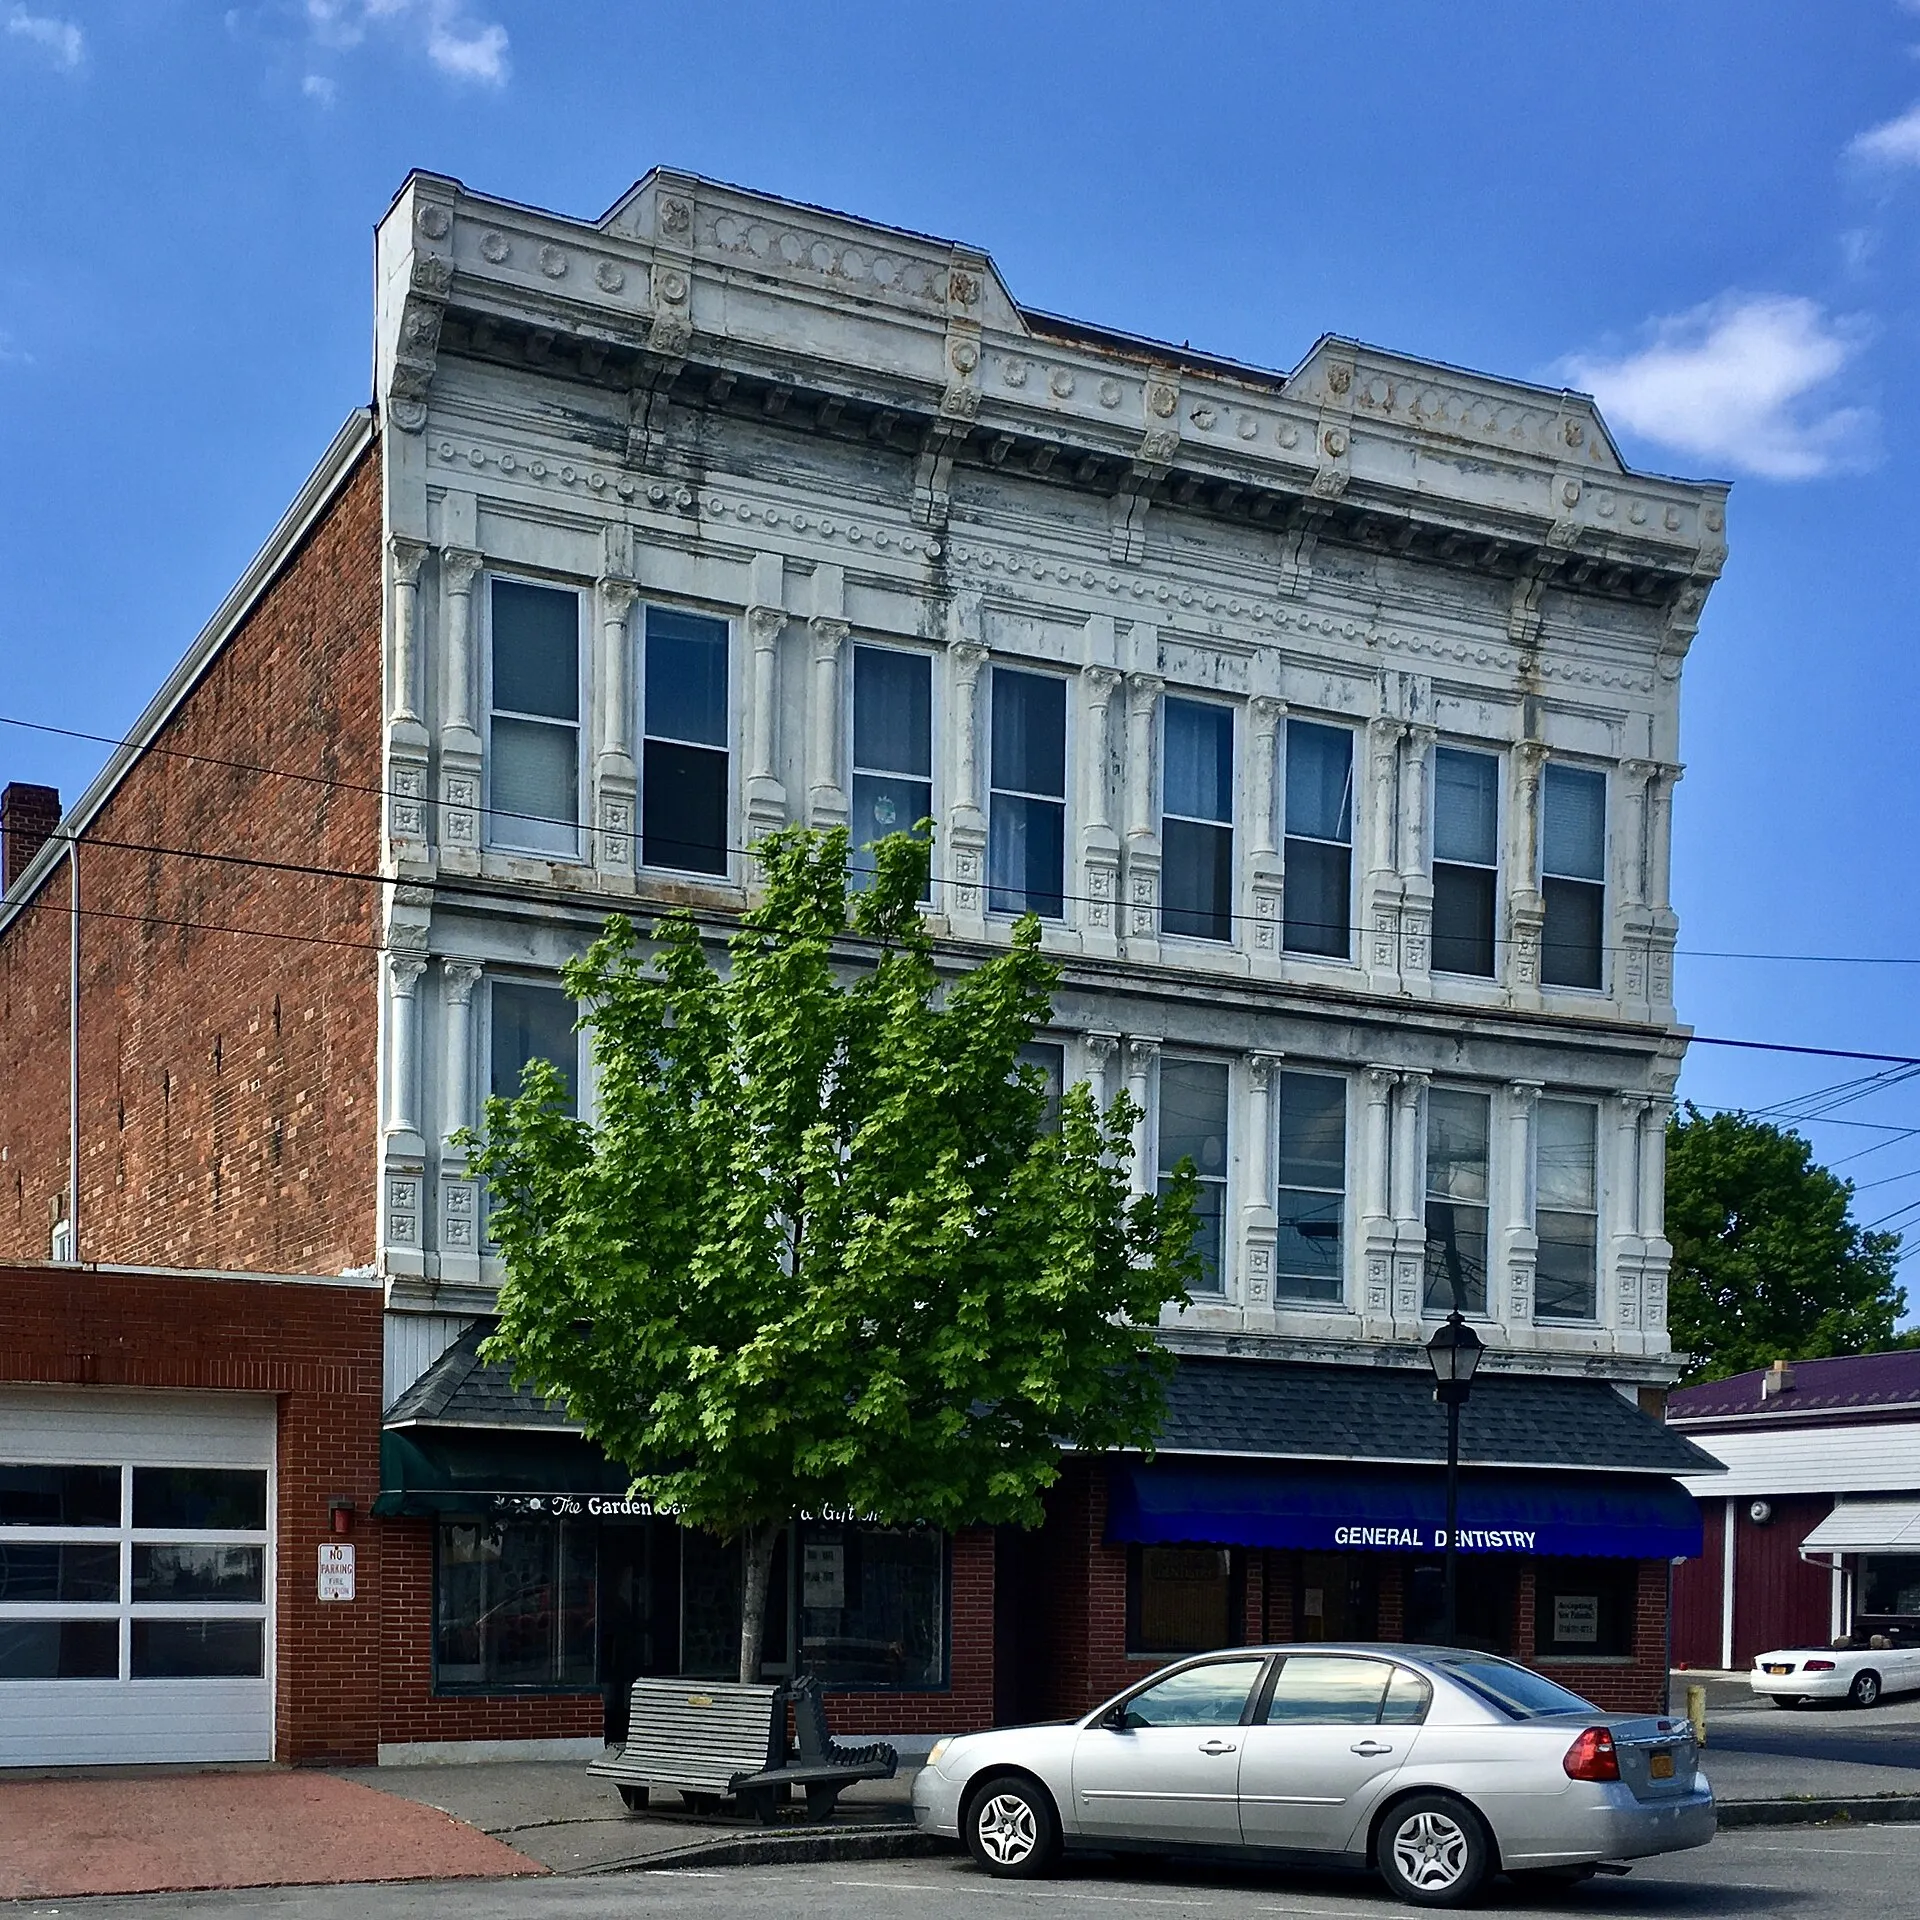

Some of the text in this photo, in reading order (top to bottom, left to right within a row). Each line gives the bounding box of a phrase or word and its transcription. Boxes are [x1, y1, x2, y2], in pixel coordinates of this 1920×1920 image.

[551, 1495, 583, 1516] The
[588, 1497, 652, 1515] Garden
[1334, 1527, 1424, 1546] GENERAL
[330, 1550, 342, 1560] NO
[321, 1564, 353, 1574] PARKING
